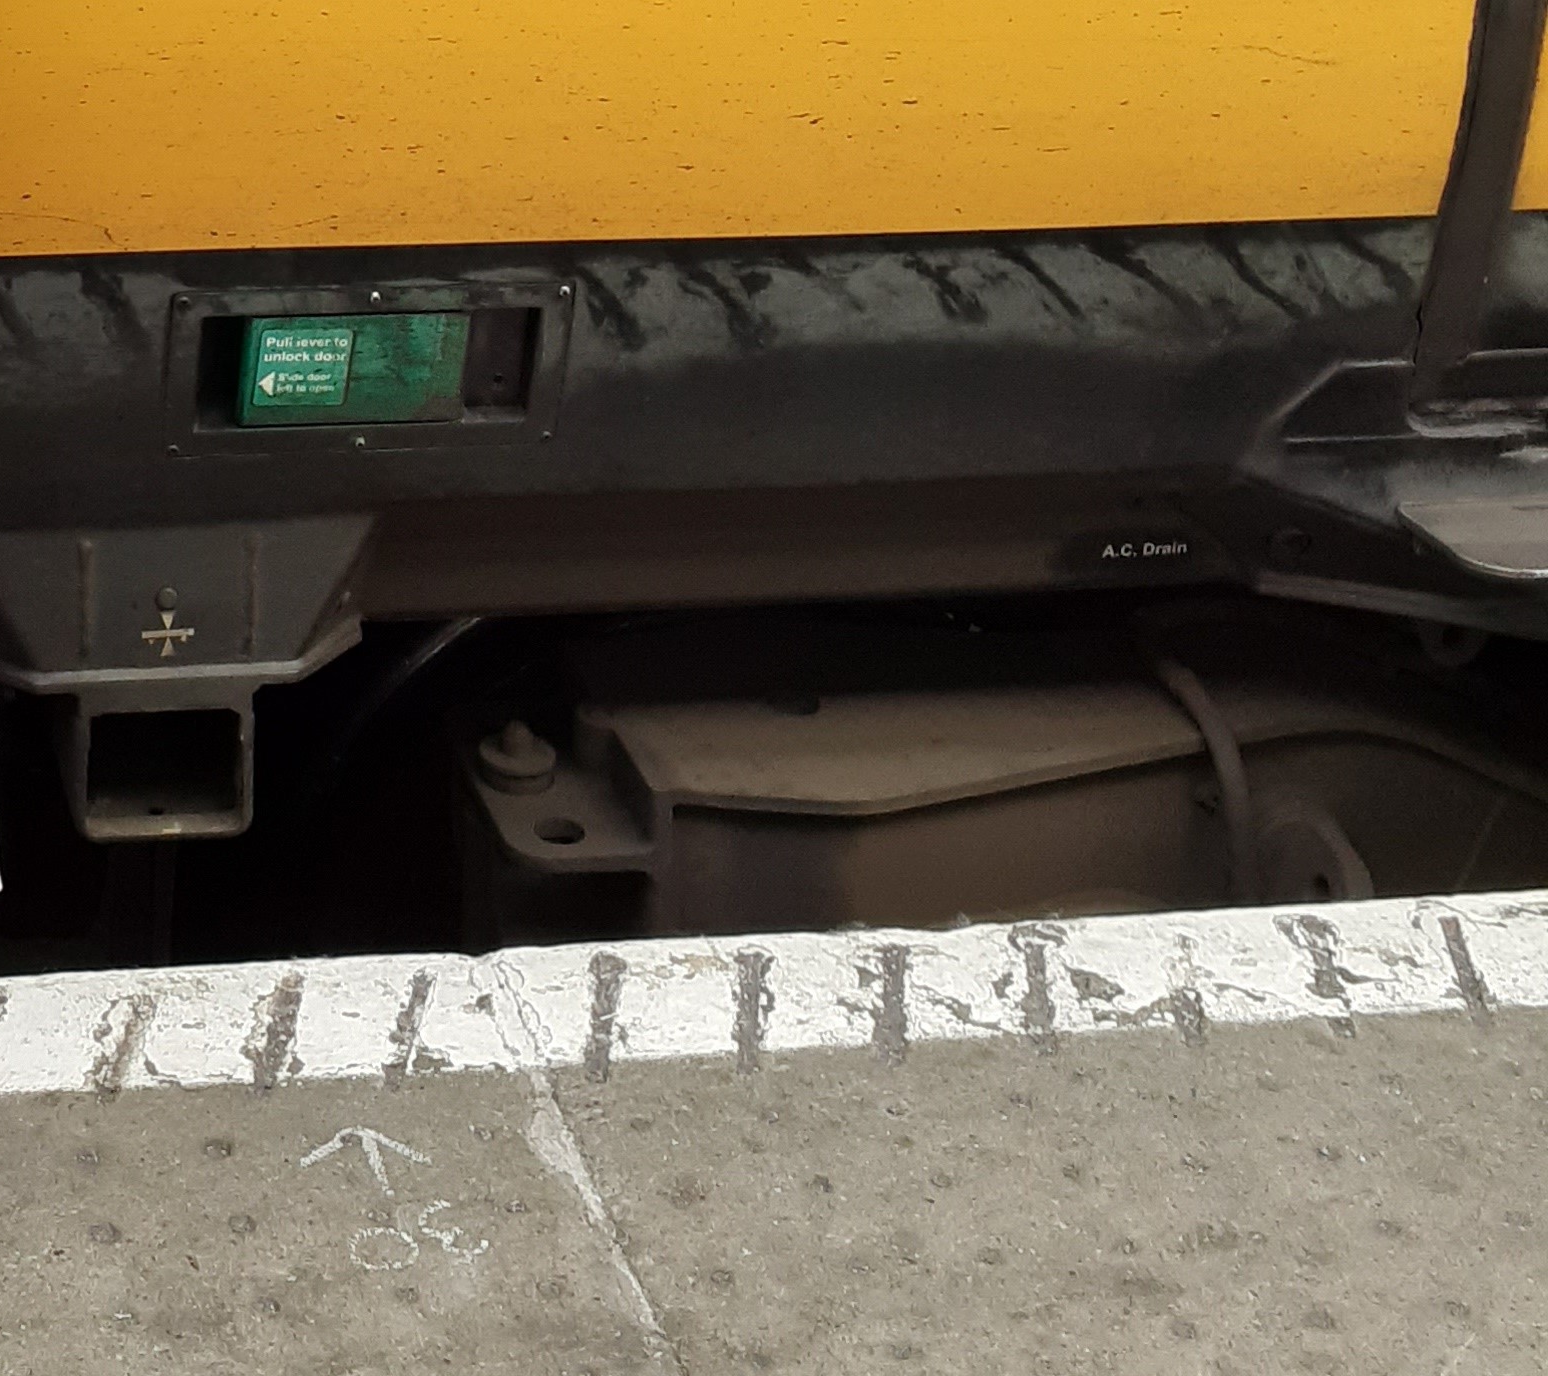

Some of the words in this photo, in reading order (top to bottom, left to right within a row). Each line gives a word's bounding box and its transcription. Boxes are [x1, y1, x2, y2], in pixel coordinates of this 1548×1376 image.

[265, 336, 293, 348] Pull
[296, 336, 332, 348] lever
[334, 336, 349, 348] to
[263, 351, 311, 362] unlock
[314, 351, 347, 362] door
[306, 372, 332, 382] door
[1142, 541, 1188, 556] Drain
